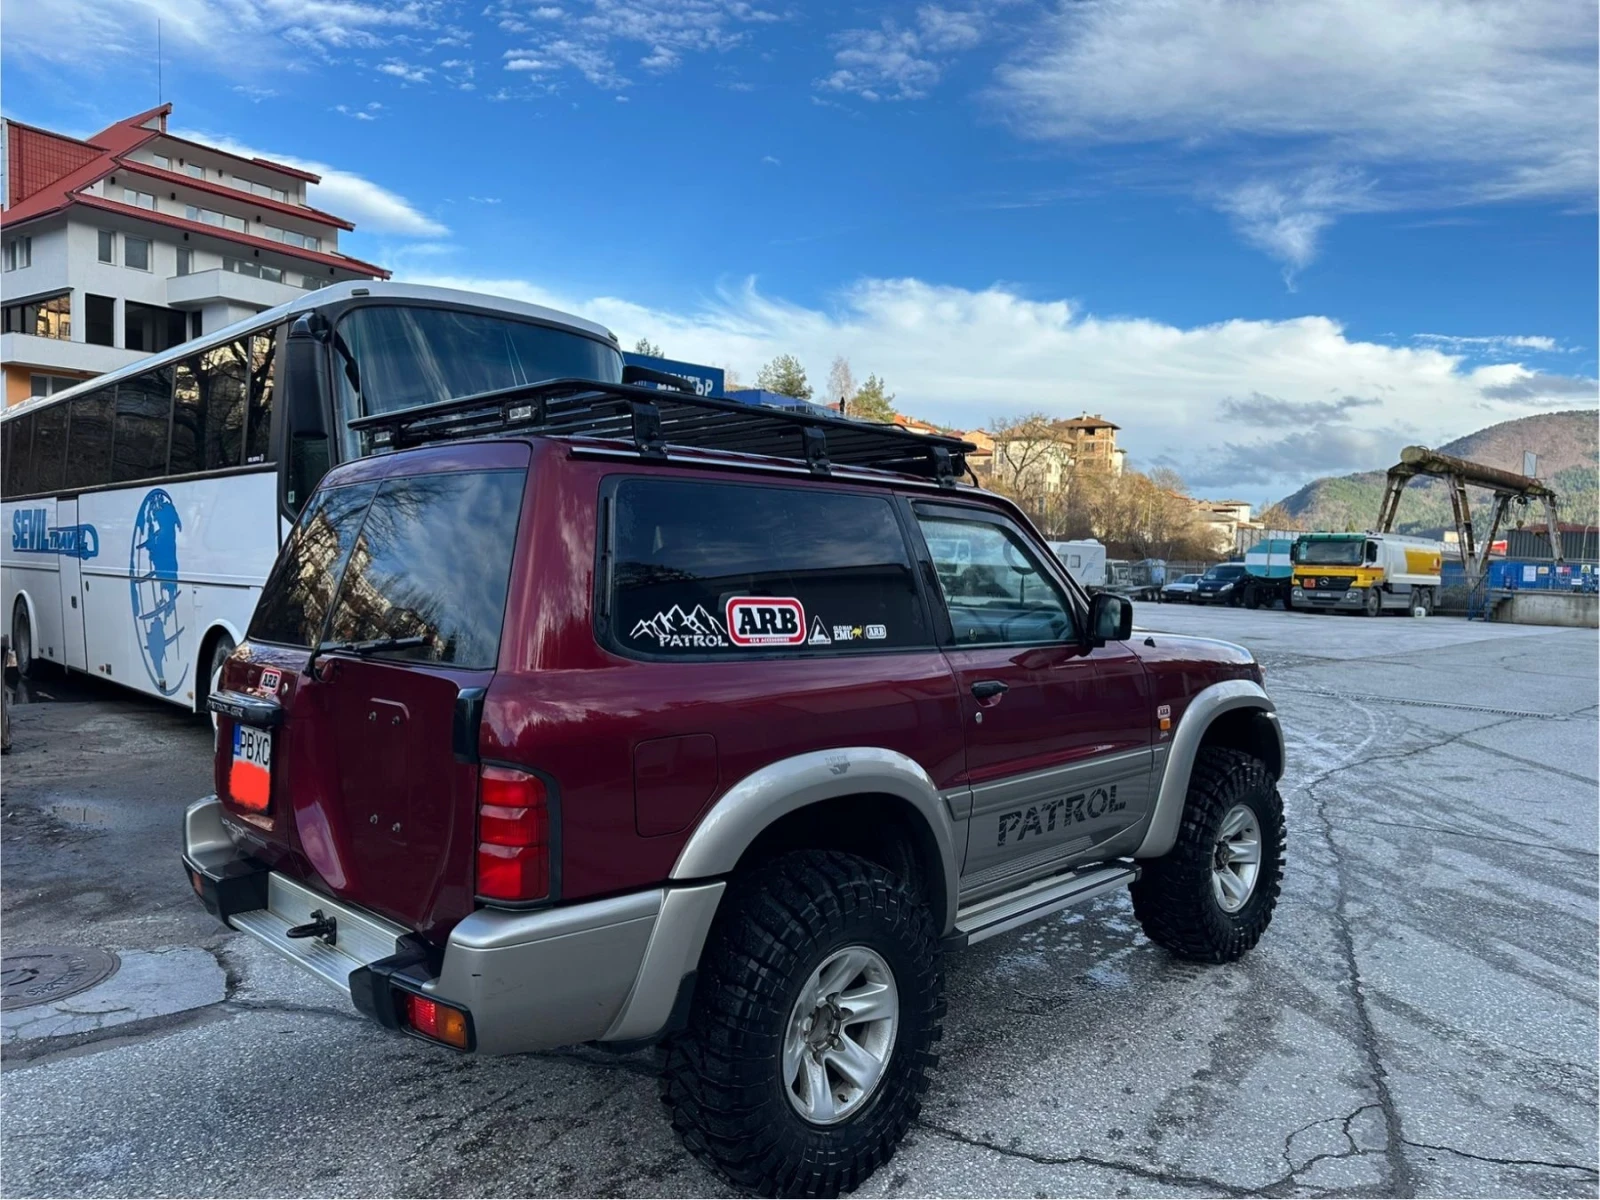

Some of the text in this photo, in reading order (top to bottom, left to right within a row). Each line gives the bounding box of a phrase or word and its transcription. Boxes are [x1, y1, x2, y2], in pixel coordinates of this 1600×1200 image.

[12, 509, 49, 550] SEVIL
[738, 607, 798, 635] ARB
[834, 631, 853, 640] EMU
[868, 627, 884, 636] ARB
[659, 634, 728, 647] PATROL
[262, 674, 277, 689] ARB
[997, 785, 1126, 846] PATROL
